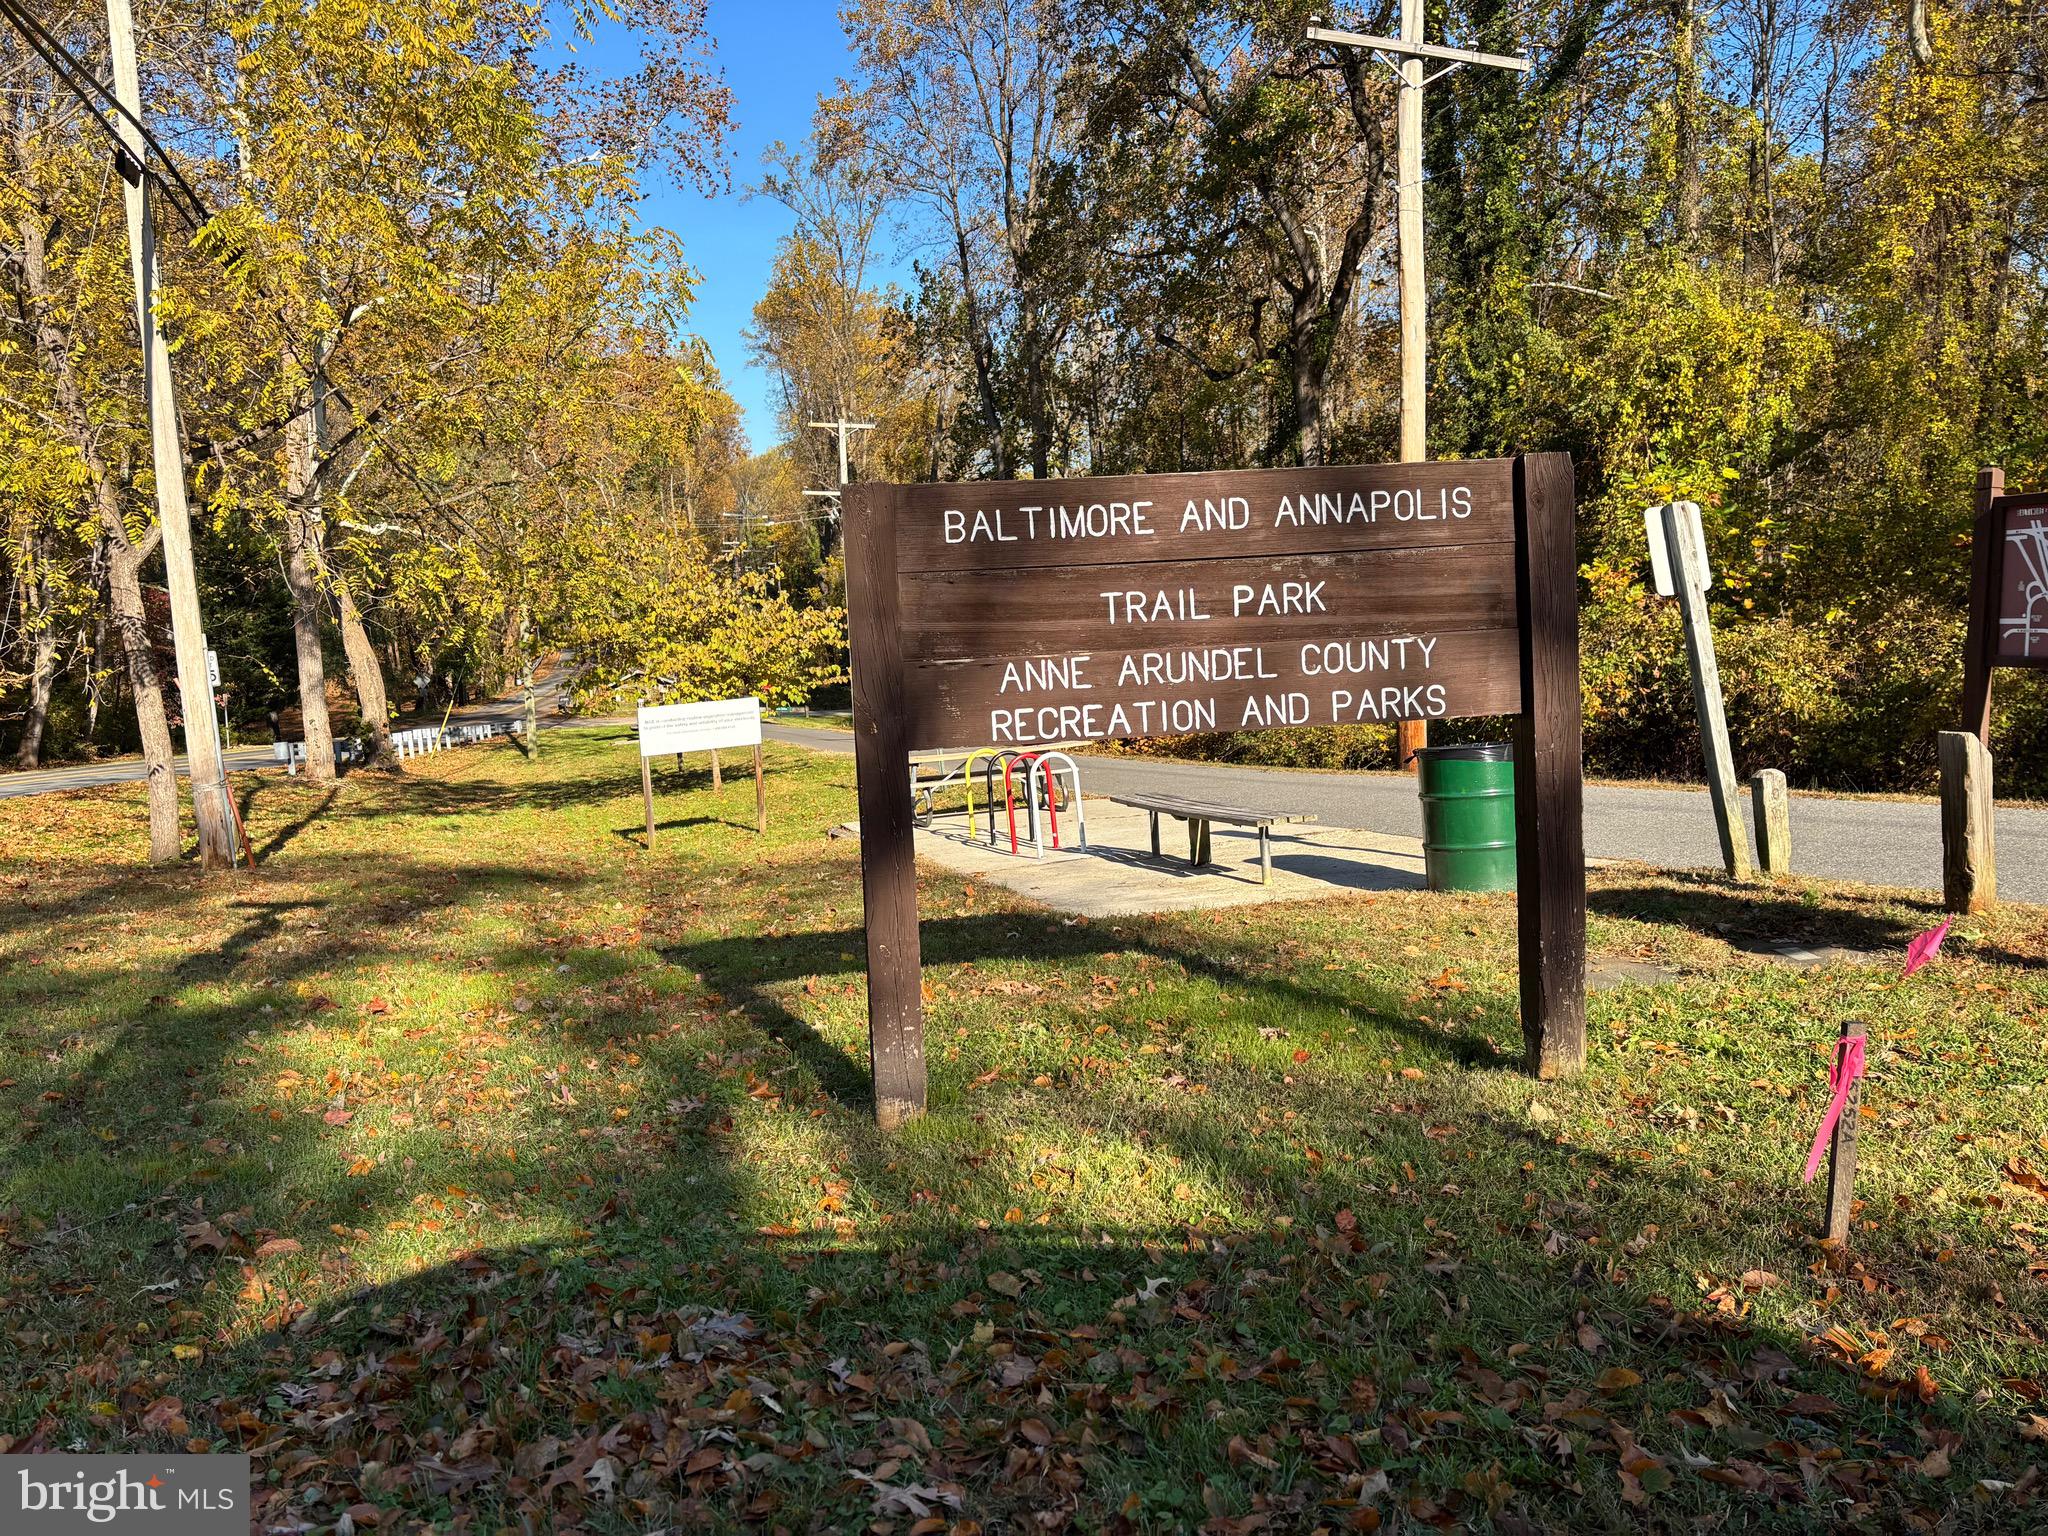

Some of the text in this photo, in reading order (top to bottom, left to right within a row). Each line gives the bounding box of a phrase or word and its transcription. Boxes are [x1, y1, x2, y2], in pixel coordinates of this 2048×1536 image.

[943, 486, 1473, 544] BALTIMORE AND ANNAPOLIS
[1099, 580, 1328, 625] TRAIL PARK
[998, 635, 1437, 695] ANNE ARUNDEL COUNTY
[990, 682, 1447, 742] RECREATION AND PARKS
